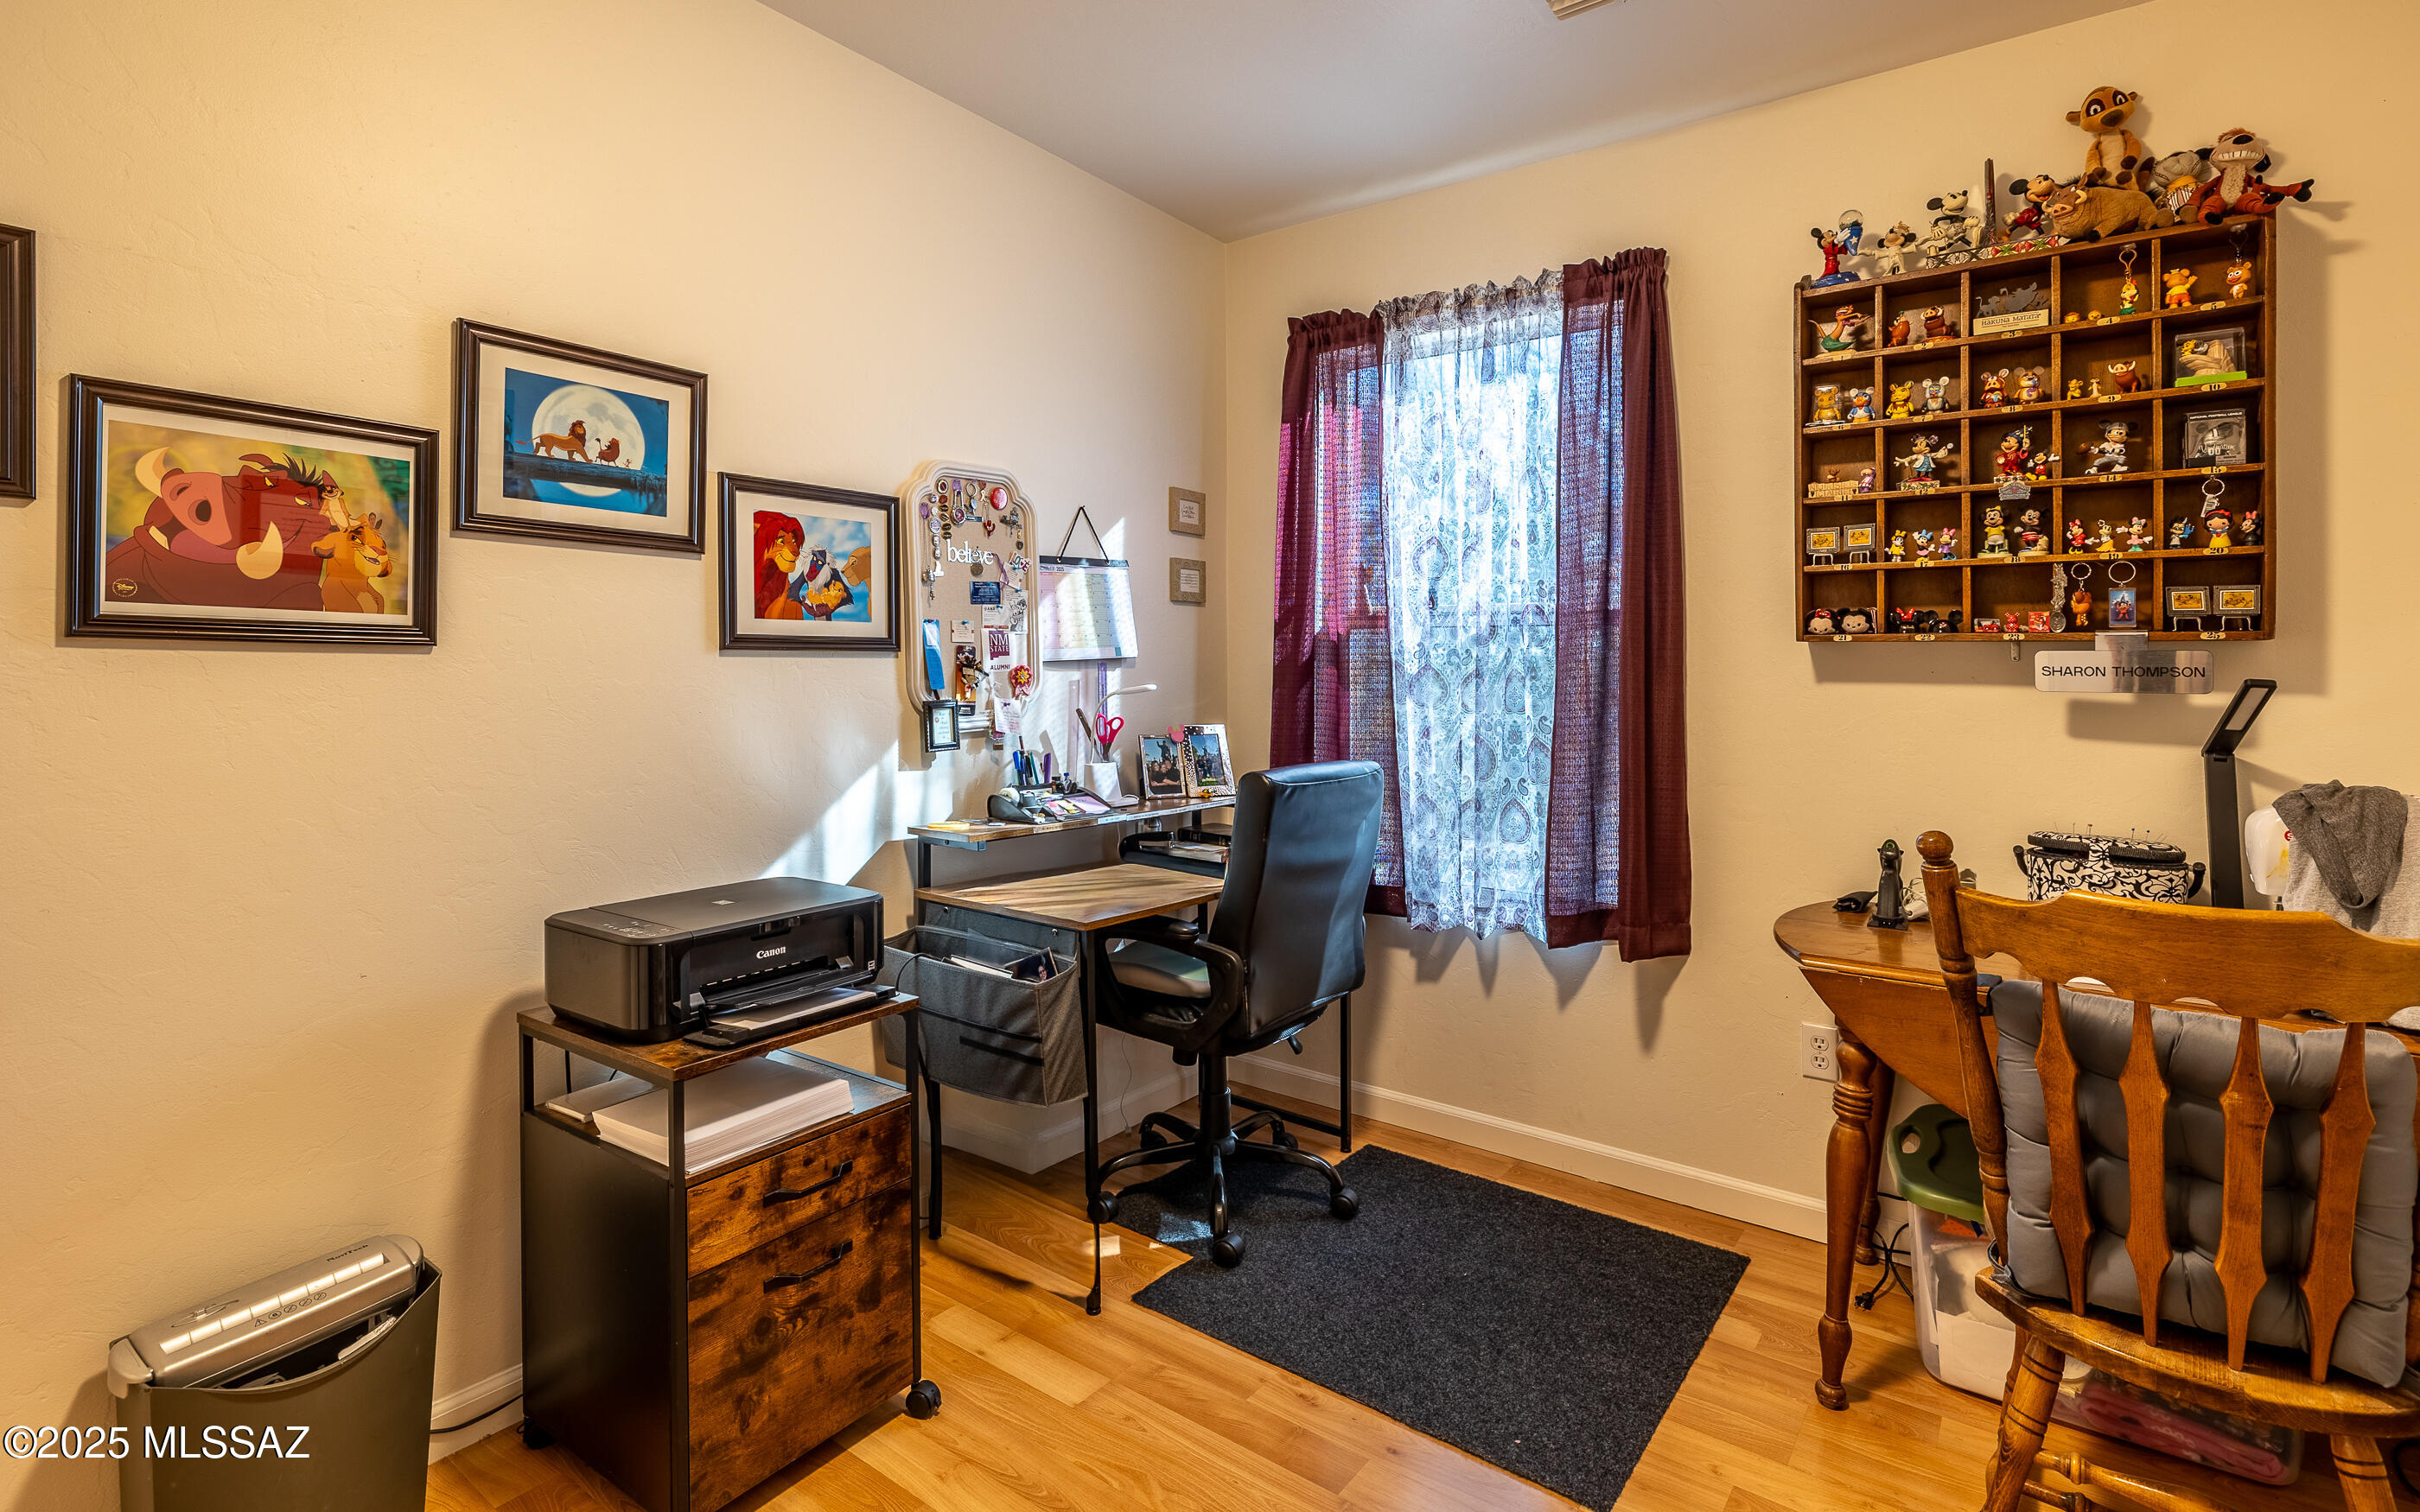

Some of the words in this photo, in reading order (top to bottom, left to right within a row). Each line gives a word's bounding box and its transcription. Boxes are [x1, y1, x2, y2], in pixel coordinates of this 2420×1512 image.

[946, 538, 994, 566] believe
[1009, 551, 1031, 574] LOVE
[990, 633, 1009, 645] NM
[2041, 665, 2106, 677] SHARON
[2111, 665, 2206, 678] THOMPSON
[755, 946, 786, 959] Canon
